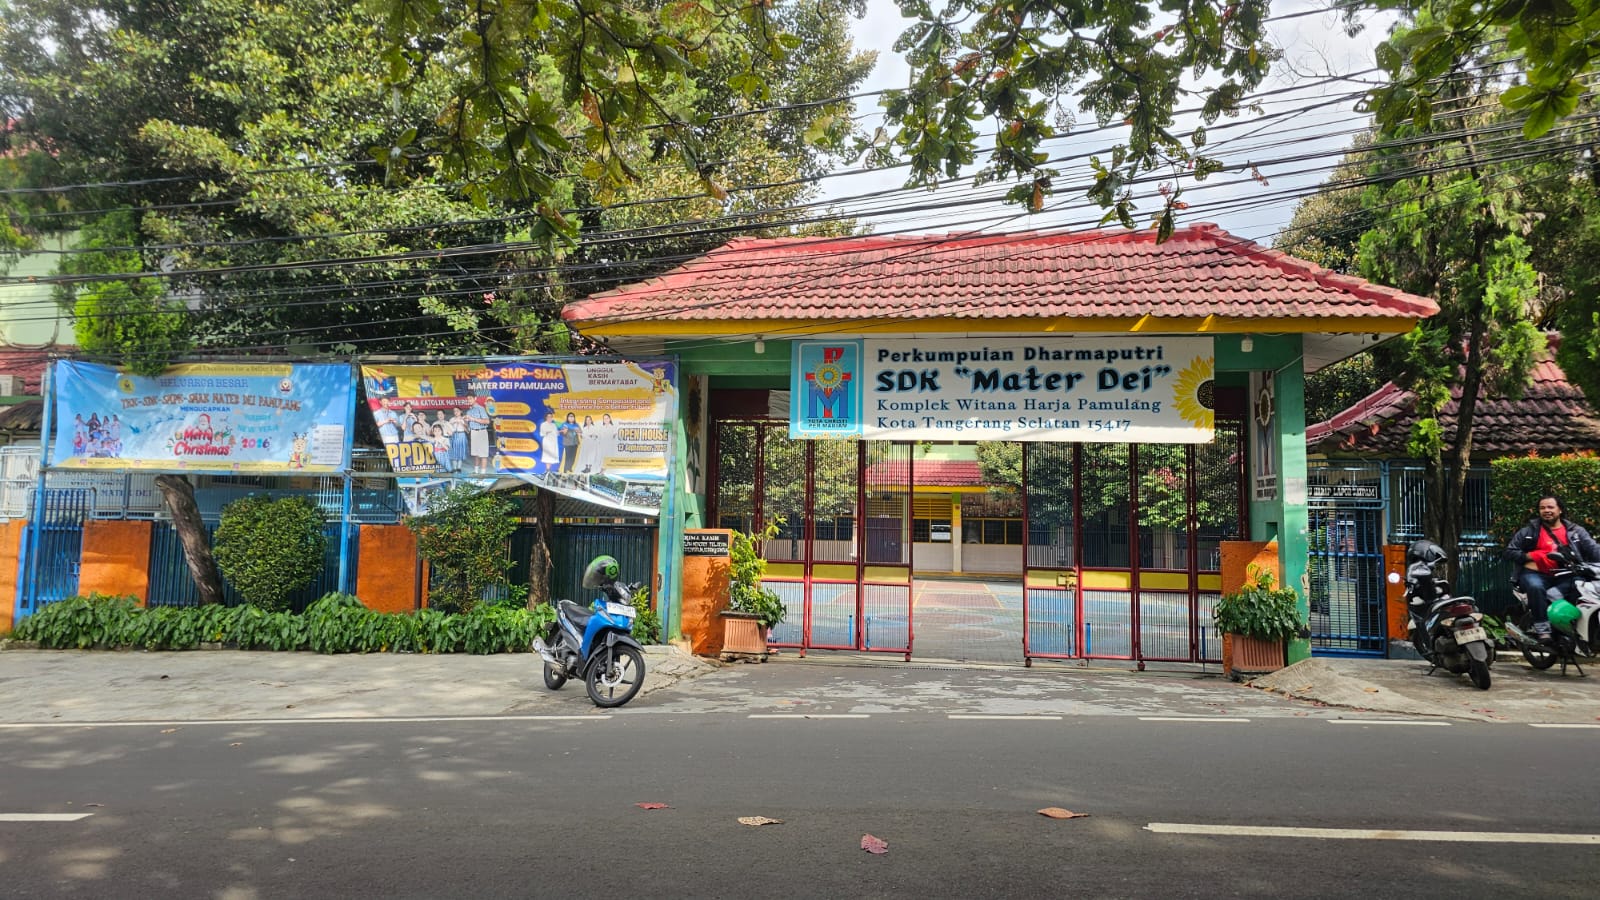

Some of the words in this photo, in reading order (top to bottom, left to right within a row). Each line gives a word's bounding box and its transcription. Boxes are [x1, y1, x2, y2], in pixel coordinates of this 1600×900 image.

[1024, 346, 1164, 363] Dharmaputri
[467, 381, 498, 391] MATER
[499, 381, 512, 390] DEI
[513, 381, 564, 391] PAMULANG
[876, 369, 940, 392] SDK
[877, 399, 951, 413] Komplek
[956, 399, 1017, 411] Witana
[1024, 398, 1071, 412] Harja
[1078, 398, 1162, 413] Pamulang
[877, 416, 916, 429] Kota
[922, 416, 1012, 431] Tangerang
[1017, 416, 1080, 429] Selatan
[1087, 419, 1131, 431] 15417
[183, 429, 213, 444] Merry
[618, 428, 640, 440] OPEN
[641, 428, 668, 440] HOUSE
[174, 441, 231, 456] Christmas
[385, 442, 436, 466] PPDB
